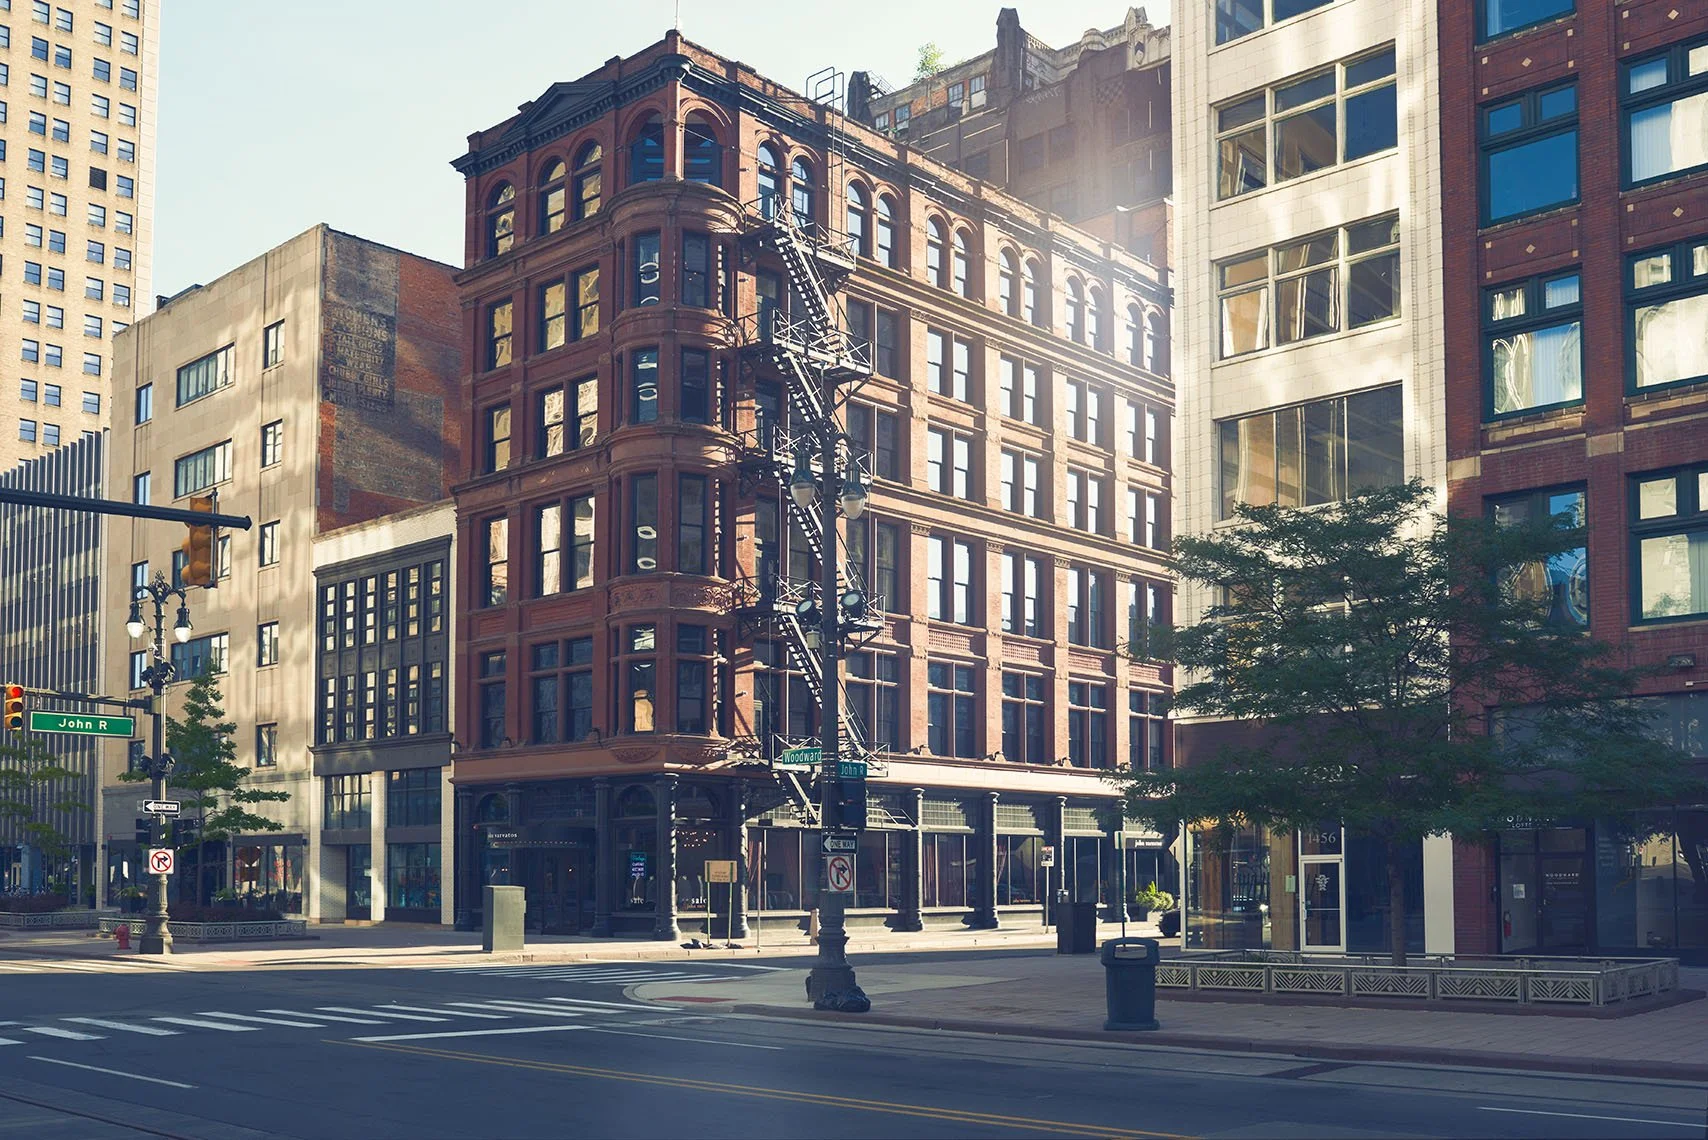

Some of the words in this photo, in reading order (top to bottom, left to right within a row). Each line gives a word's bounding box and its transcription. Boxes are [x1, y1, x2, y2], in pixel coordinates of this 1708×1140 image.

[363, 373, 389, 389] GIRLS
[58, 718, 92, 729] John
[99, 720, 108, 730] R
[784, 750, 822, 763] Woodward
[841, 764, 858, 775] John
[859, 766, 864, 775] R
[1308, 831, 1336, 844] 1456
[829, 840, 841, 849] ONE
[842, 840, 855, 849] WAY
